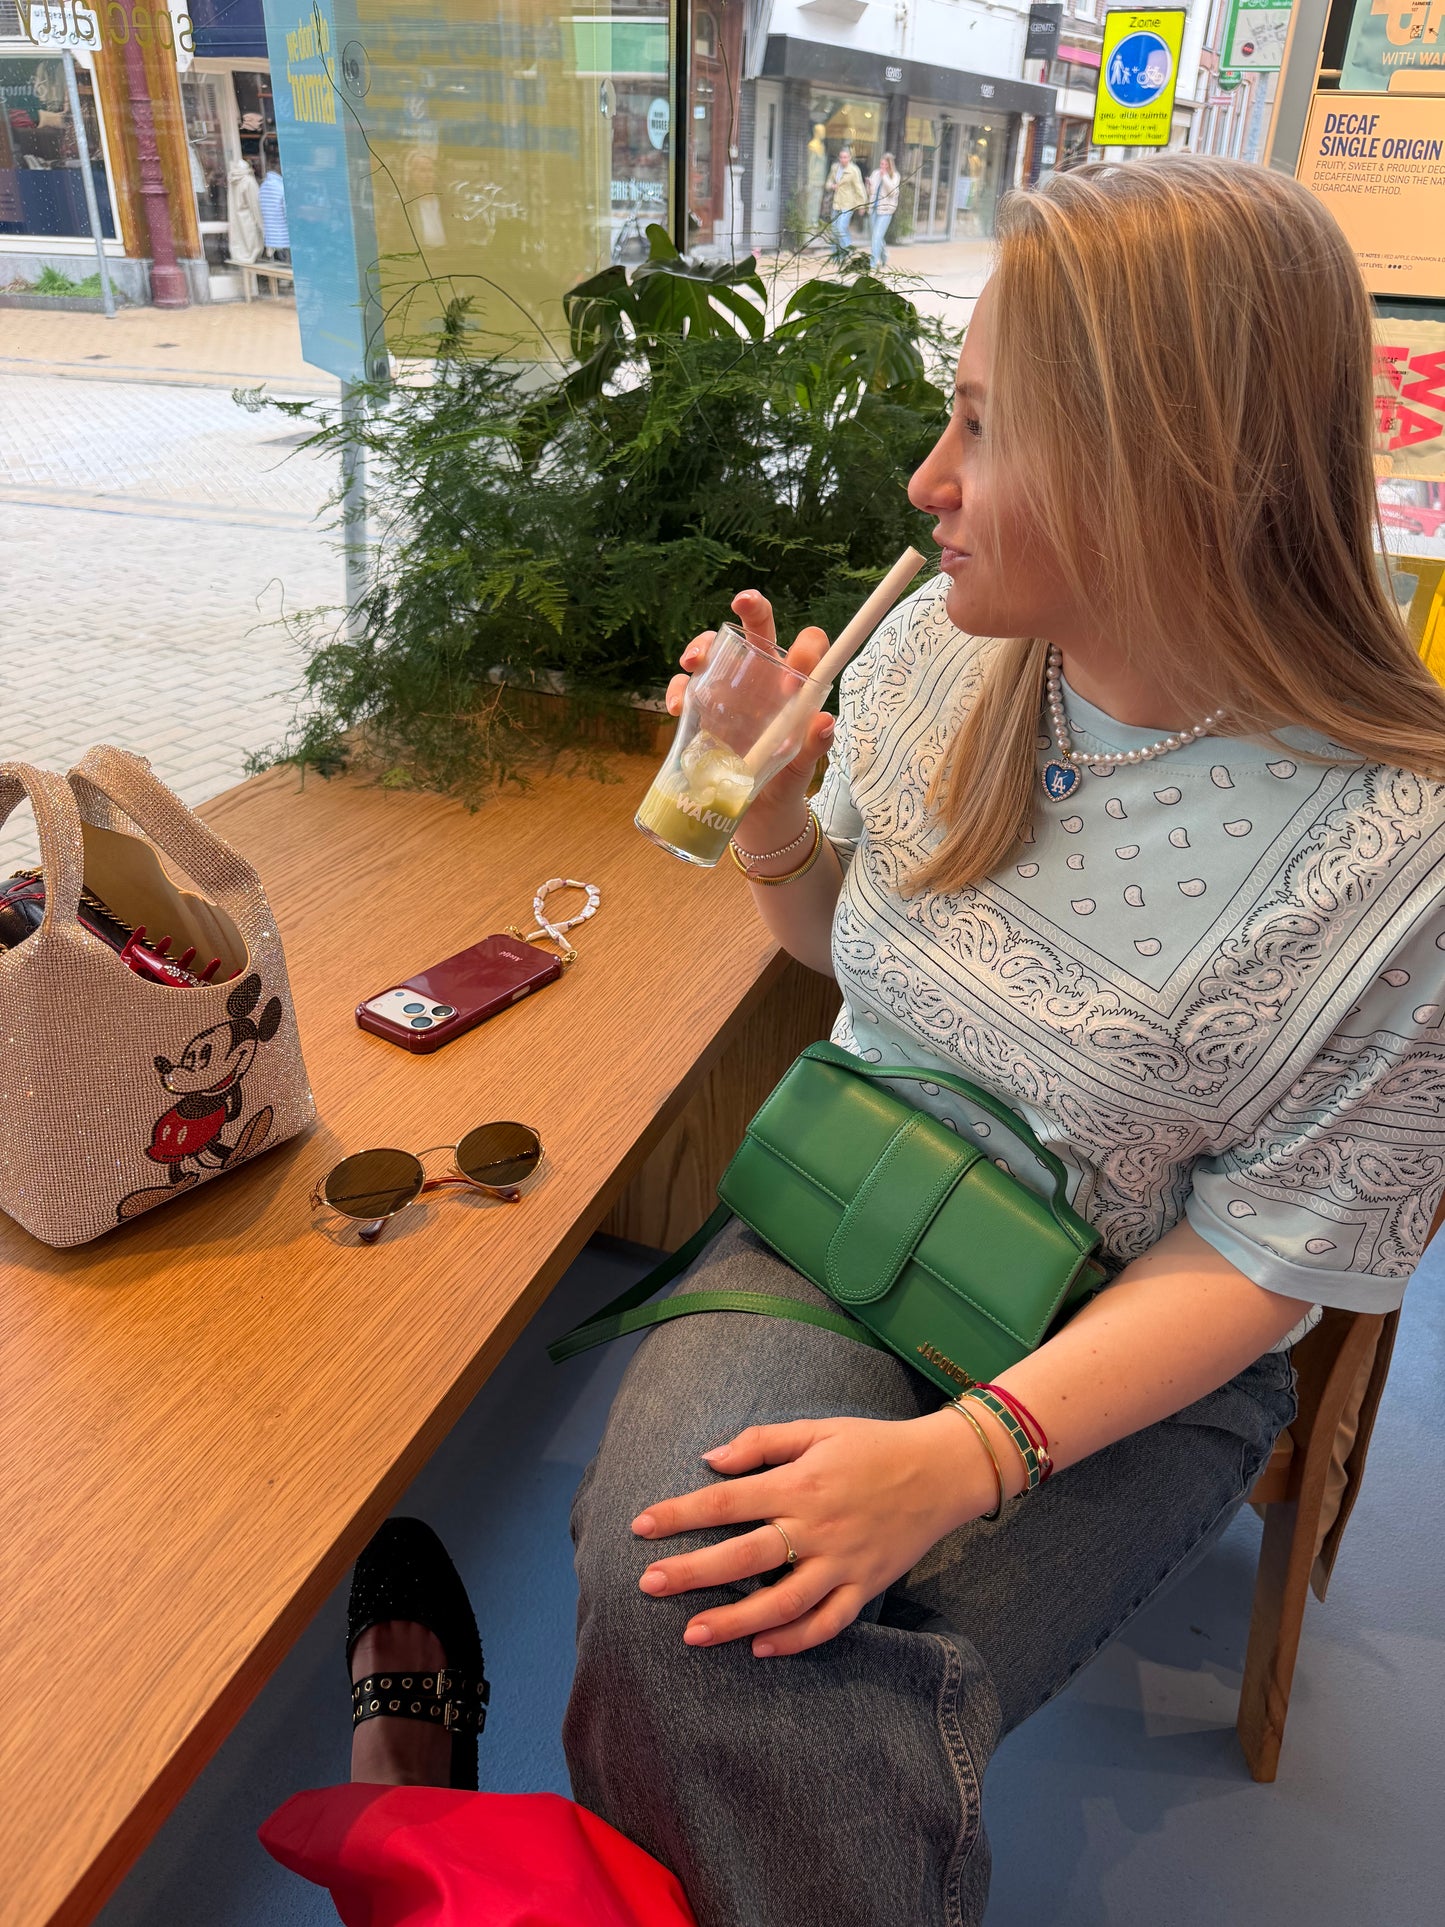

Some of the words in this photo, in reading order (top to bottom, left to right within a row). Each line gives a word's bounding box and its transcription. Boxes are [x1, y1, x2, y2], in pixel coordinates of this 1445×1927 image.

[1128, 16, 1161, 28] Zone
[1382, 51, 1416, 65] WITH
[1324, 113, 1380, 135] DECAF
[1319, 136, 1381, 158] SINGLE
[1382, 138, 1443, 160] ORIGIN
[1316, 160, 1347, 171] FRUITY,
[1348, 161, 1378, 171] SWEET
[1378, 163, 1384, 172] &
[1386, 163, 1427, 173] PROUDLY
[1313, 172, 1382, 183] DECAFFEINATED
[1383, 174, 1410, 184] USING
[1412, 175, 1429, 185] THE
[1311, 183, 1362, 194] SUGARCANE
[1364, 185, 1402, 196] METHOD.
[1051, 770, 1066, 794] LA
[676, 792, 738, 833] WAKULI
